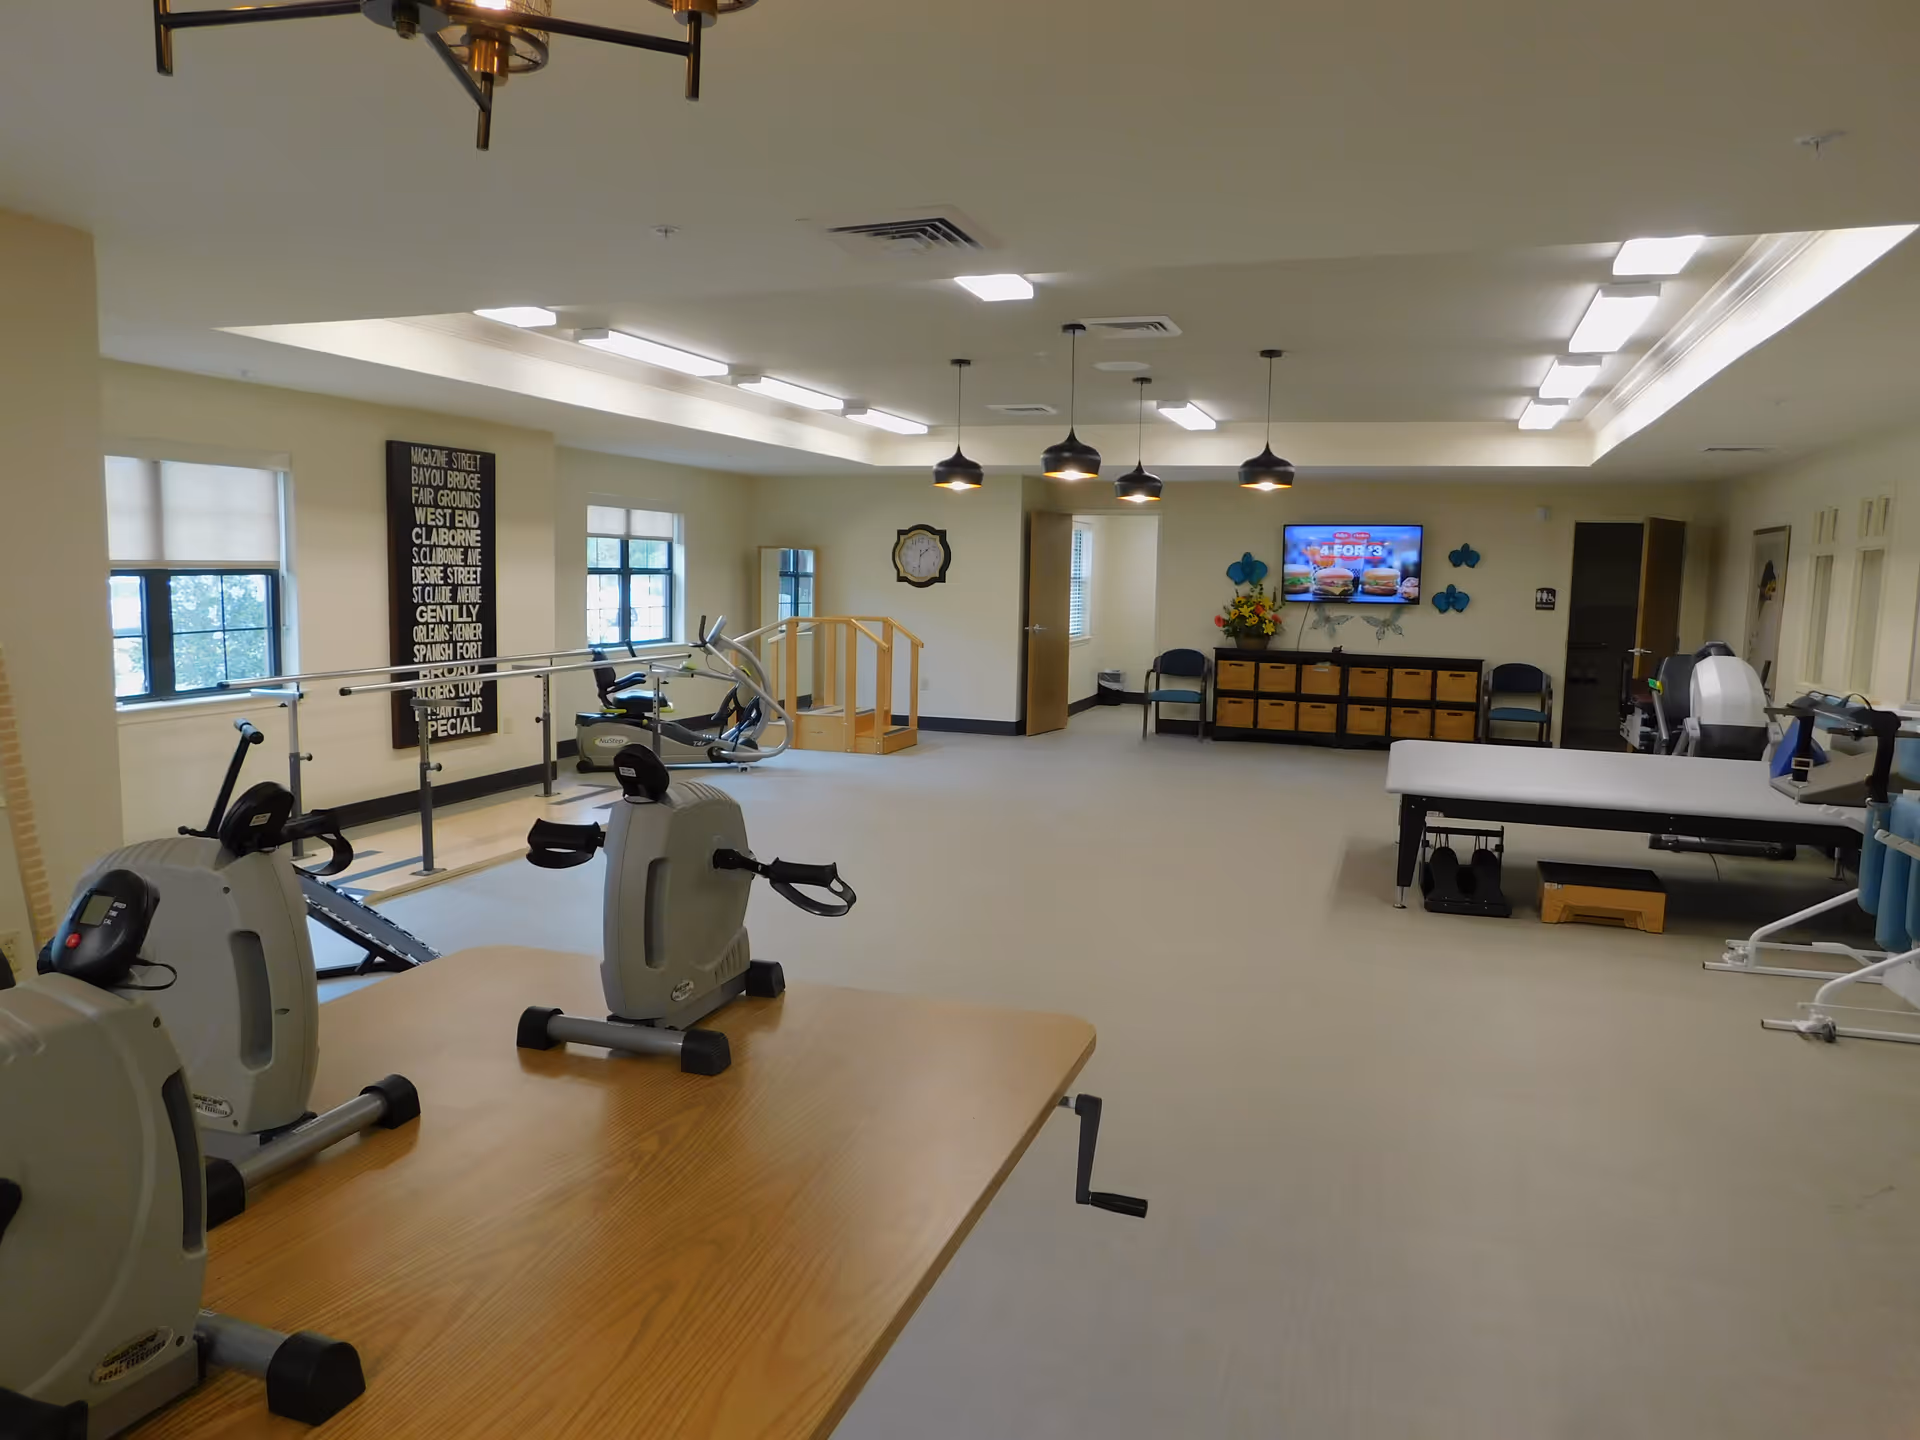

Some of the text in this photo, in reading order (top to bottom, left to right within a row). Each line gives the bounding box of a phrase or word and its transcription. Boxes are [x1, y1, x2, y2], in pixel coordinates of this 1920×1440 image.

[411, 446, 481, 471] MAGAZINE STREET
[411, 466, 481, 491] BAYOU BRIDGE
[411, 487, 481, 508] FAIR GROUNDS
[415, 507, 480, 528] WEST END
[411, 527, 481, 546] CLAIBORNE
[467, 548, 482, 566] AVE
[1320, 545, 1329, 556] 4
[1334, 544, 1365, 556] FOR
[411, 566, 482, 585] DESIRE STREET
[424, 586, 452, 604] CLAUDE
[456, 586, 482, 603] AVENUE
[415, 604, 480, 623] GENTILLY
[413, 641, 482, 663] SPANISH FORT
[418, 665, 479, 680] BROAD
[416, 681, 483, 699] ALGIERS LOOP
[419, 716, 481, 738] PECIAL
[599, 737, 624, 745] NuStep
